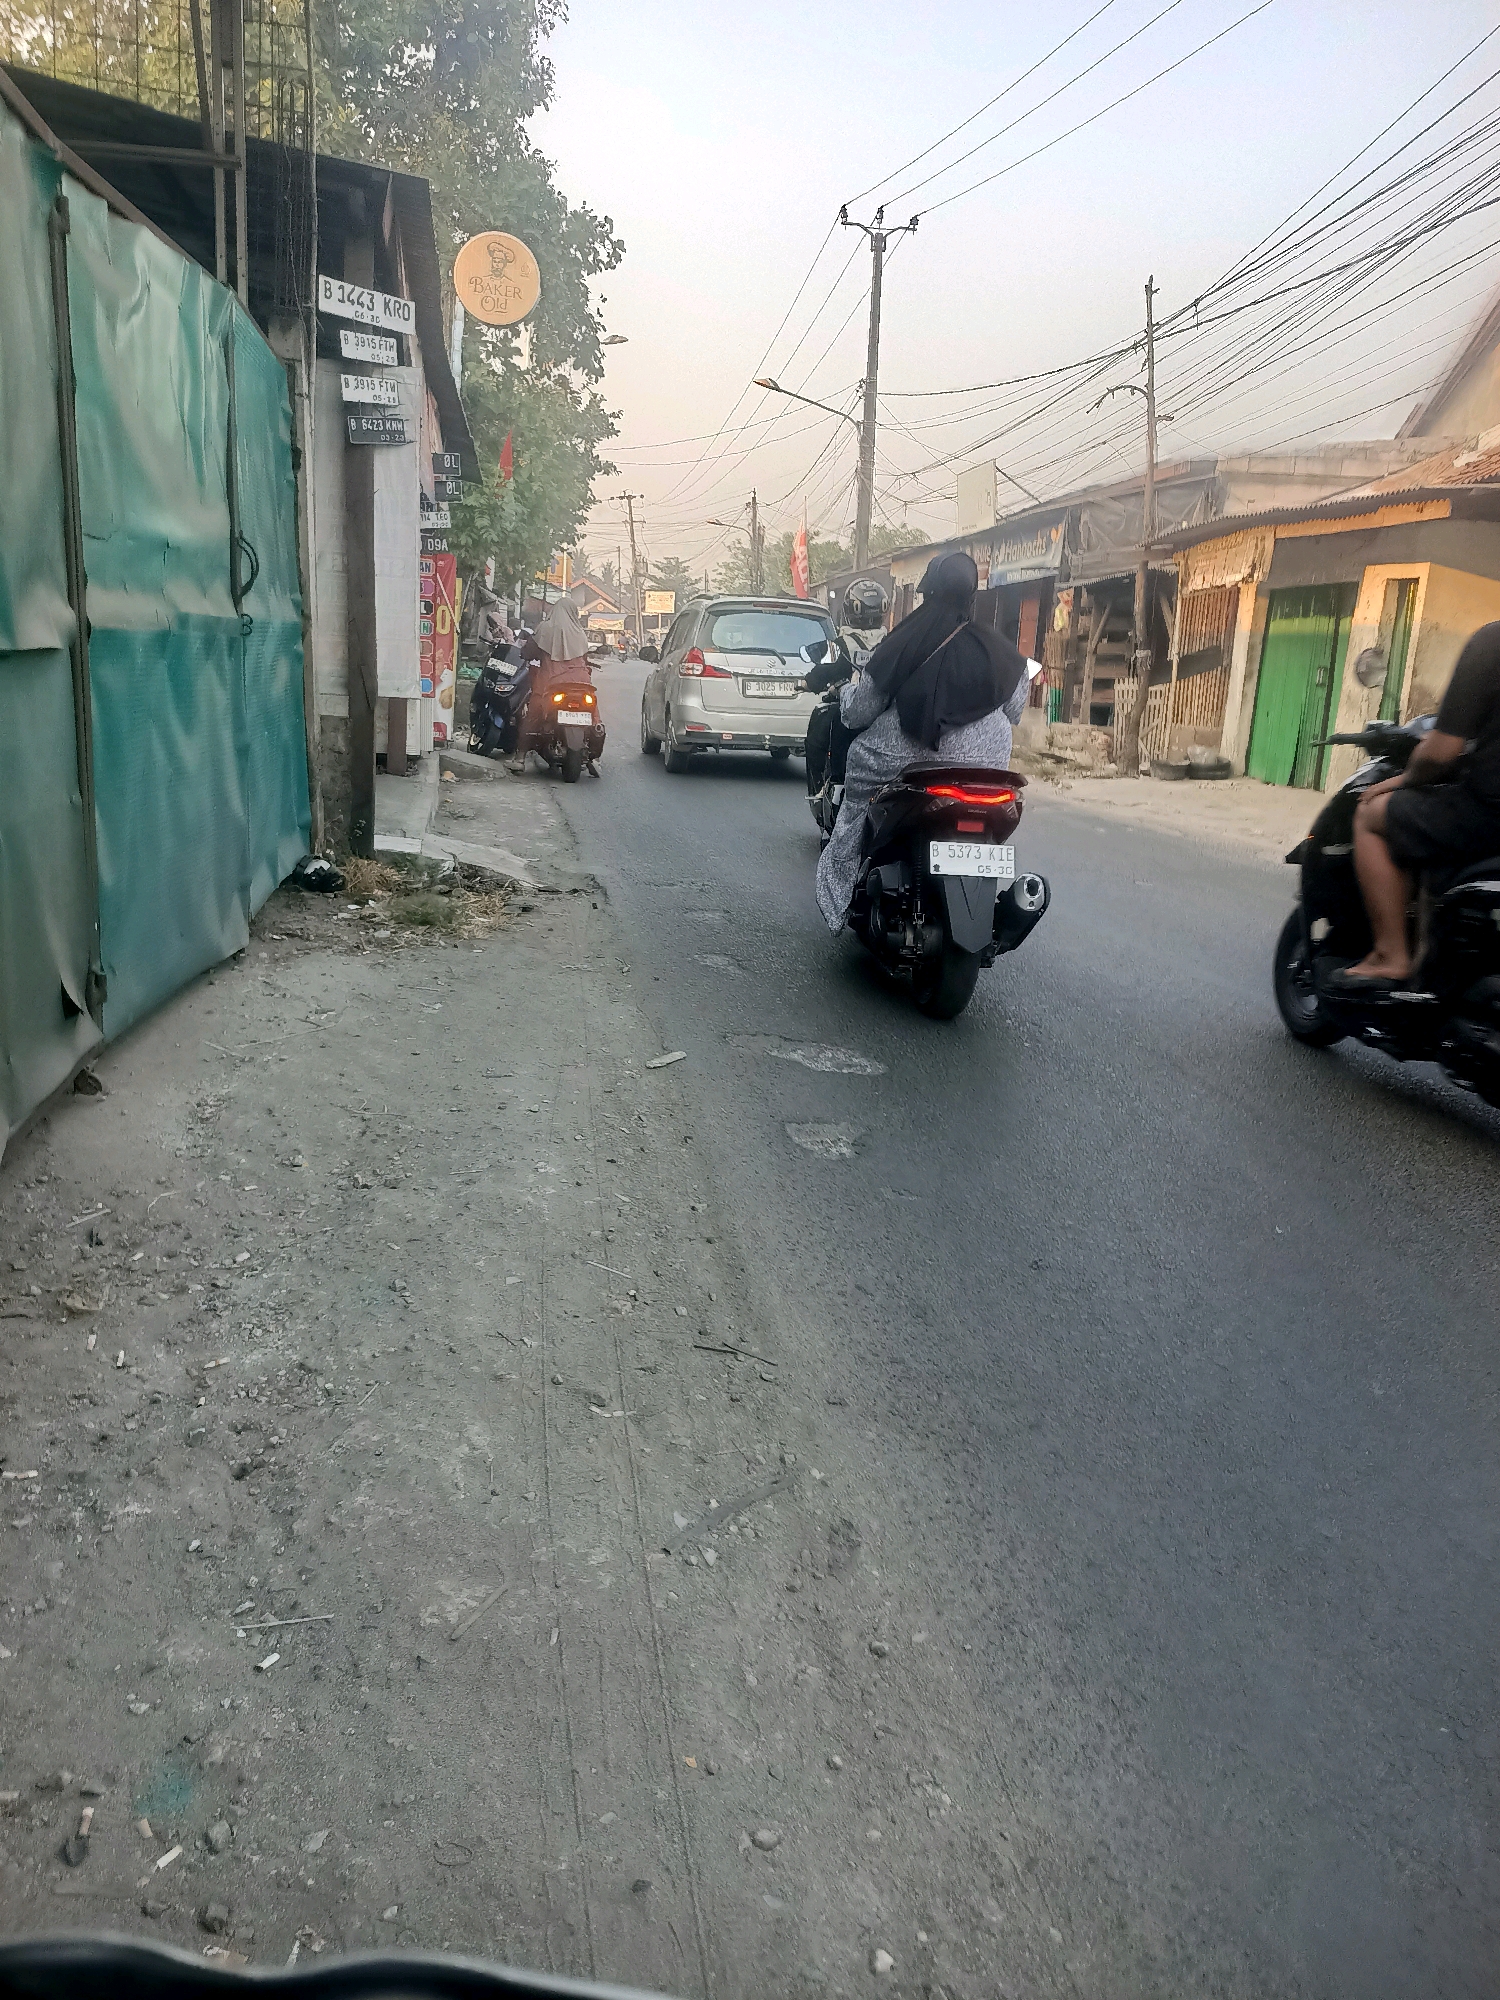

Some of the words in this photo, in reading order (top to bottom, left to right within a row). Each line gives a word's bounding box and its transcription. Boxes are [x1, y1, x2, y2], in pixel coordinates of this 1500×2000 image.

[469, 276, 523, 300] BAKER
[324, 279, 333, 300] B
[337, 284, 375, 312] 1443
[383, 296, 411, 322] KRO
[480, 295, 508, 314] Old
[343, 333, 349, 345] B
[354, 335, 377, 350] 3915
[344, 376, 350, 389] B
[353, 377, 376, 391] 3915
[350, 418, 357, 431] B
[361, 418, 384, 431] 6423
[931, 843, 940, 858] B
[948, 844, 982, 860] 5373
[988, 847, 1014, 862] KIE
